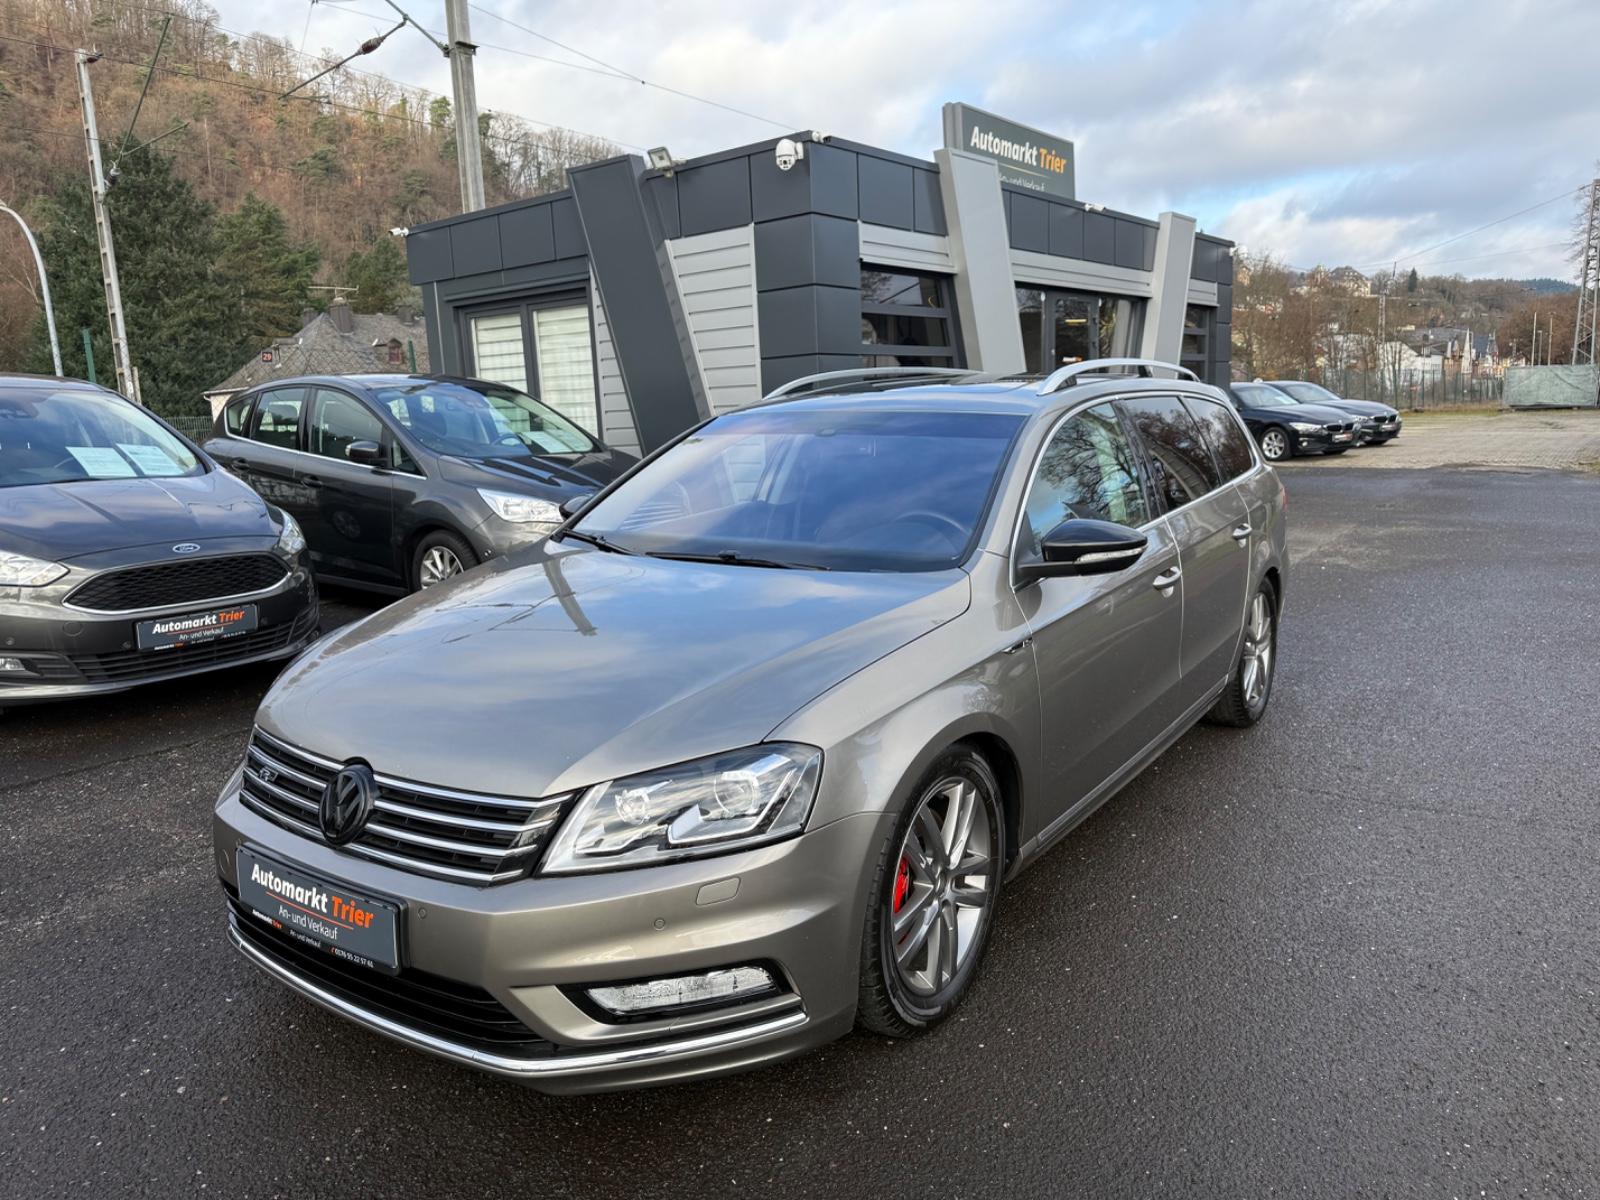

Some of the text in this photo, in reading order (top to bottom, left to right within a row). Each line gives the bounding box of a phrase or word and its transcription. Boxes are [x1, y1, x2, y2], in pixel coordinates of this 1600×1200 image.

[970, 126, 1067, 173] Automarkt Trier
[152, 610, 245, 634] Automarkt Trier
[191, 630, 203, 639] und
[203, 626, 224, 637] Verkauf
[251, 863, 375, 929] Automarkt Trier
[279, 904, 338, 940] An- und Verkauf
